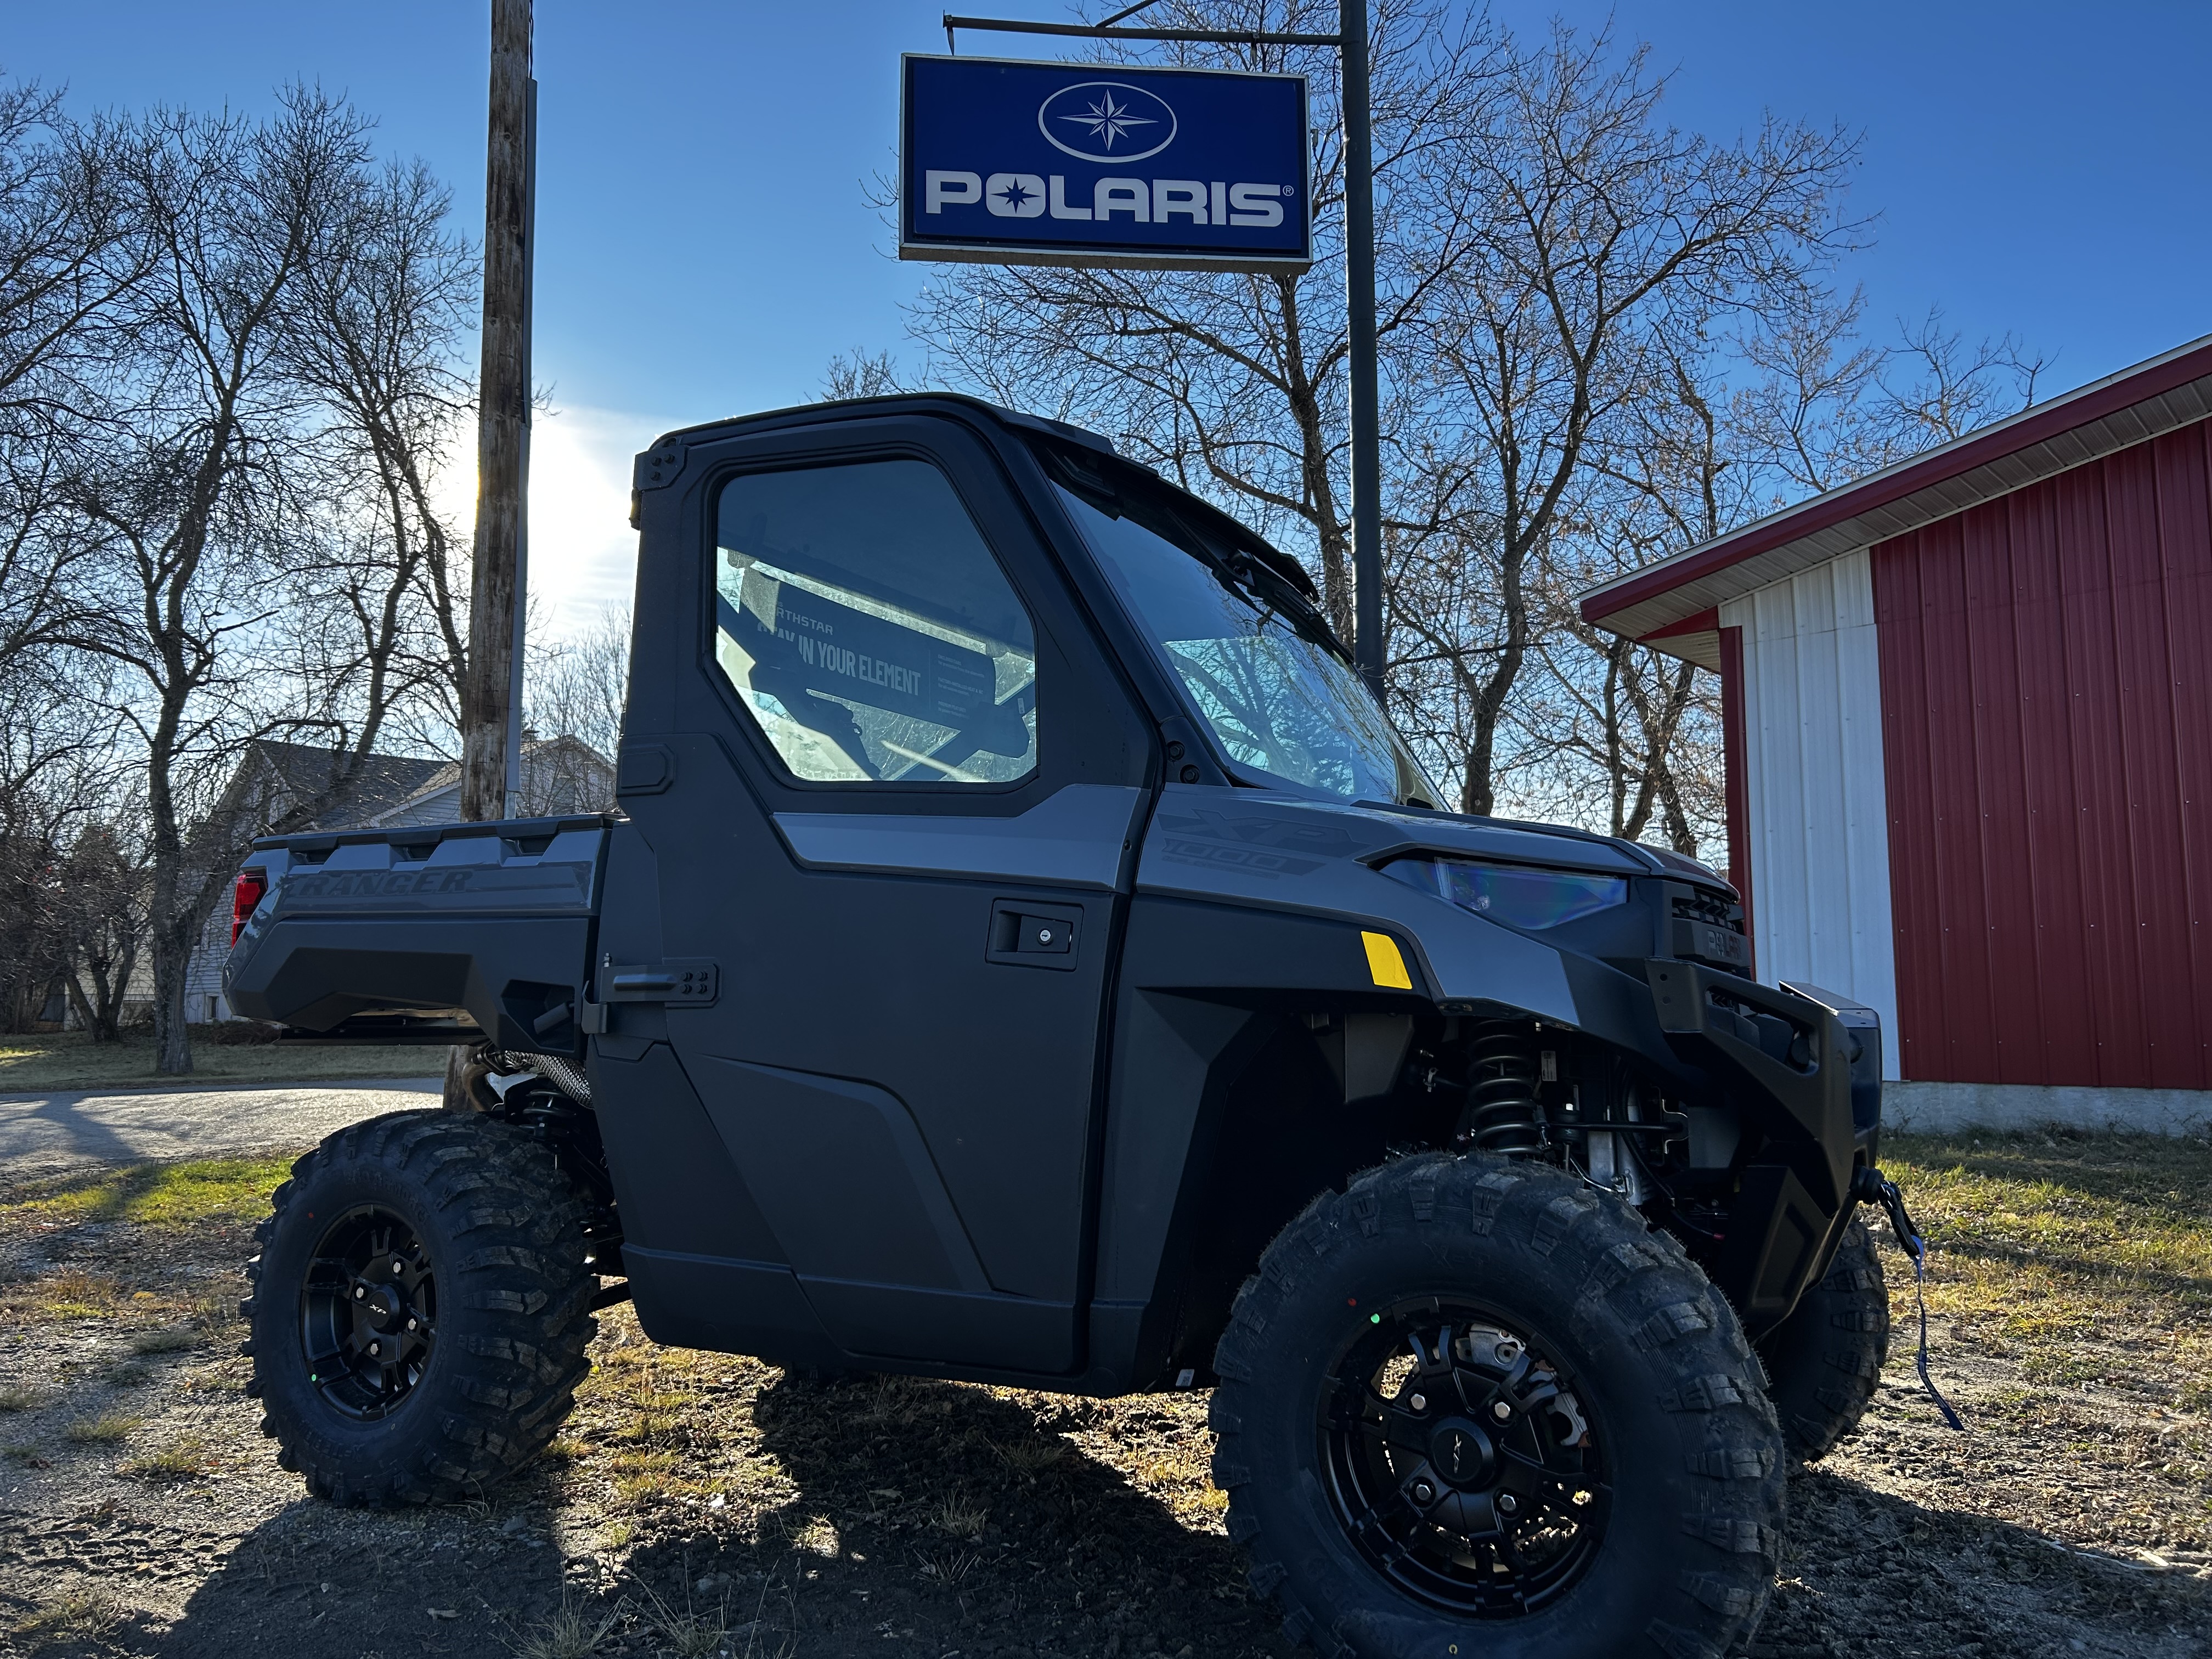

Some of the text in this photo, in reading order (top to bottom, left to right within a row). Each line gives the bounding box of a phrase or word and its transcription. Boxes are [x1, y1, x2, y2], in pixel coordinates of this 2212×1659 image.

[926, 169, 1284, 228] POLARIS
[776, 607, 833, 636] RTHSTAR
[817, 641, 856, 678] YOUR
[859, 653, 922, 696] ELEMENT
[296, 870, 475, 895] RANGER
[369, 1304, 386, 1314] XP
[1453, 1433, 1463, 1474] XP
